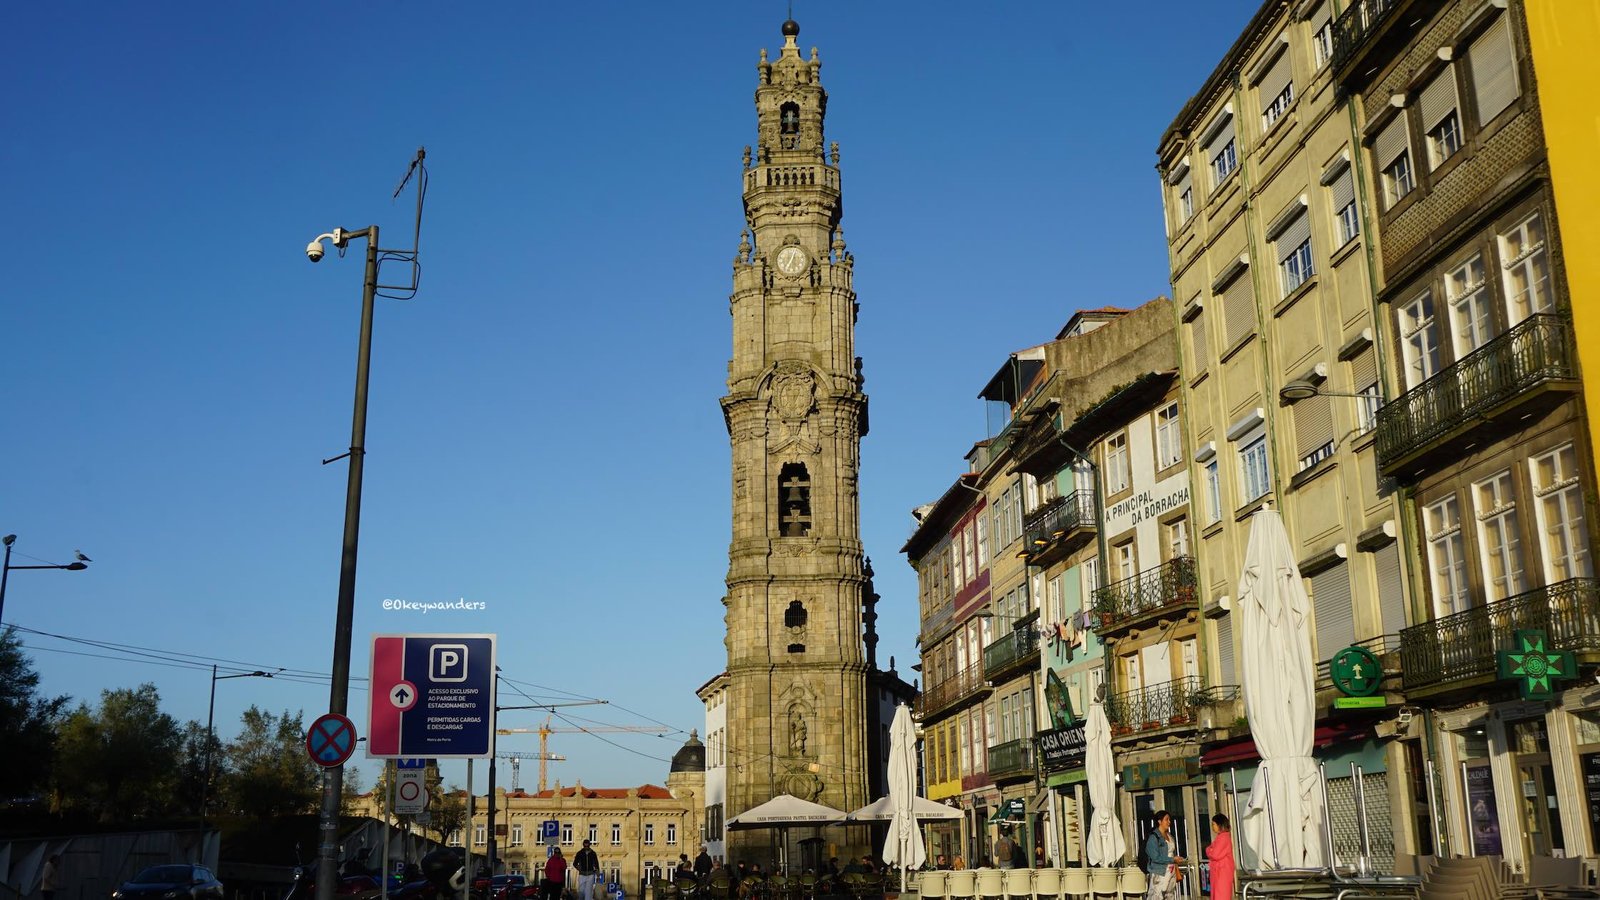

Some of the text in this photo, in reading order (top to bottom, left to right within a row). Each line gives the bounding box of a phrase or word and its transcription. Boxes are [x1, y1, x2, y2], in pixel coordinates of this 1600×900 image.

[1106, 490, 1153, 523] A PRINCIPAL
[1132, 487, 1189, 525] DA BORRACHA
[441, 651, 459, 675] P
[1041, 726, 1087, 751] CASA ORIEN
[546, 823, 556, 836] P
[608, 884, 616, 893] P
